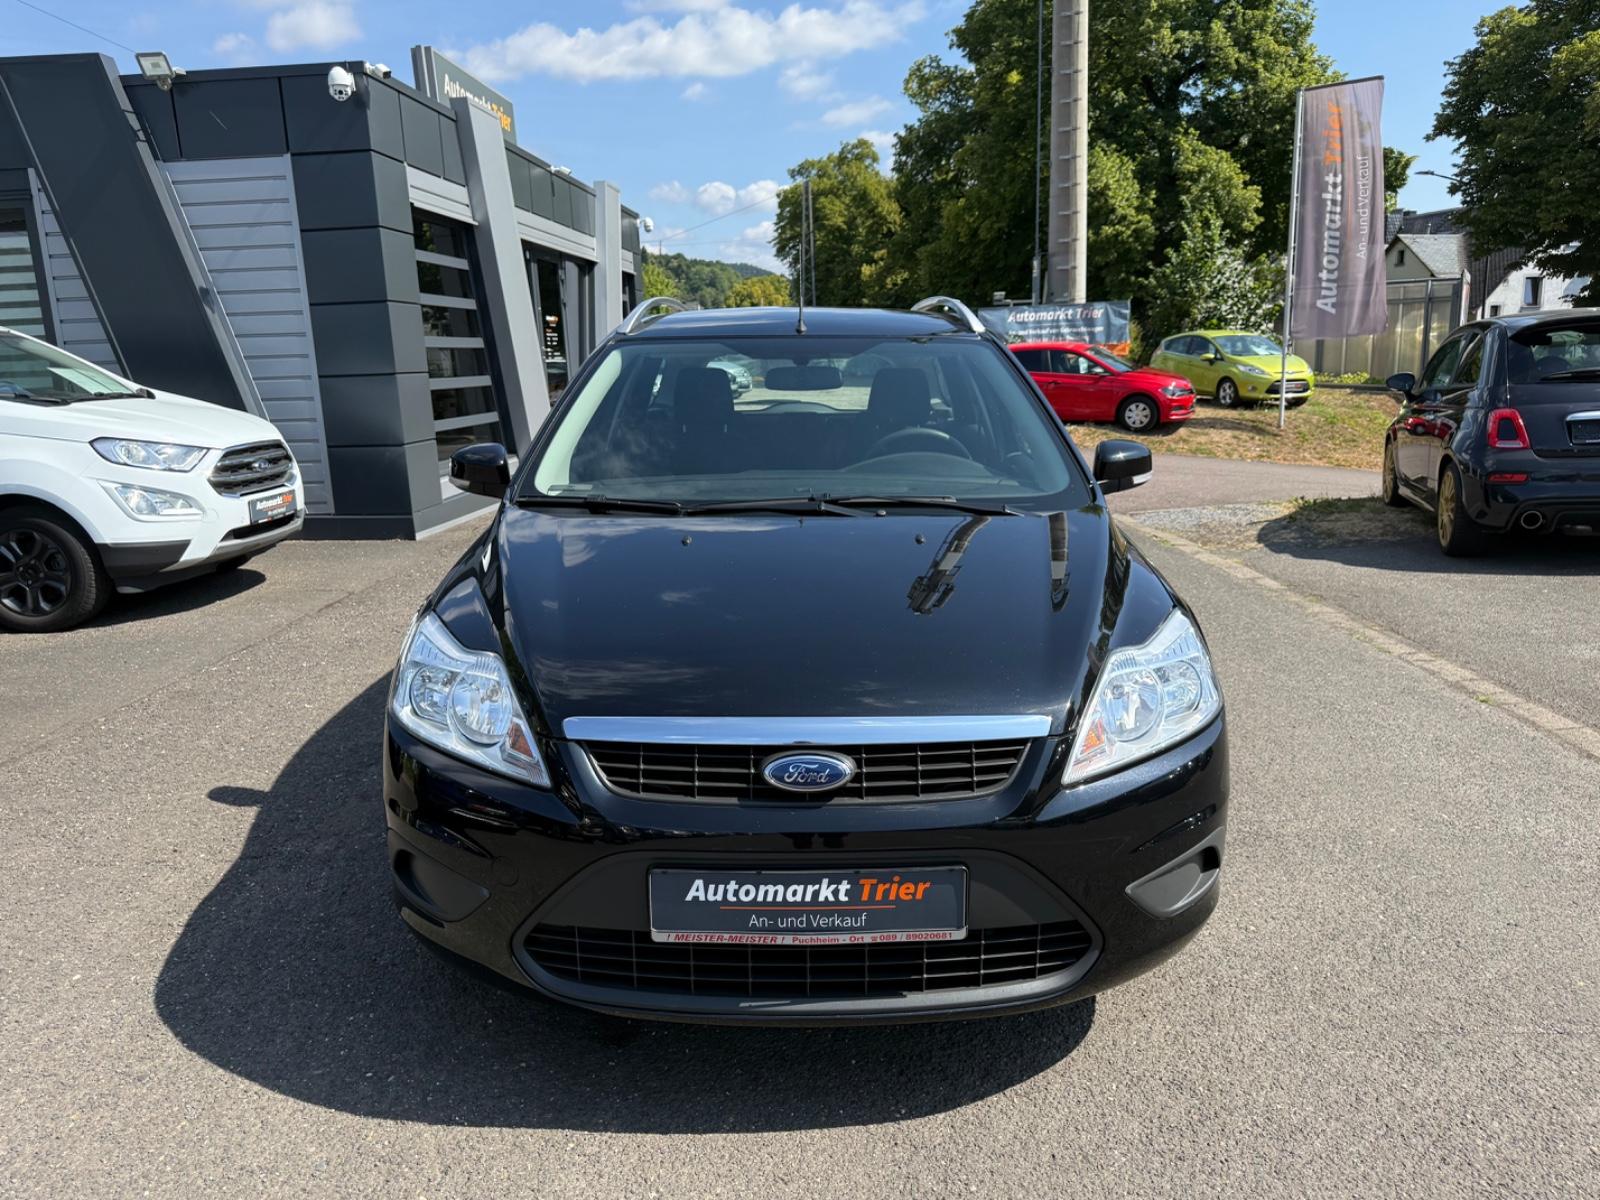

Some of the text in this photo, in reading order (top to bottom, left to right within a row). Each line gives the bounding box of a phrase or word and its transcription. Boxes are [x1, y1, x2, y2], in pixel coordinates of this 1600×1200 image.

[1316, 100, 1344, 315] Automarkt Trier
[1356, 154, 1369, 259] An- und Verkauf
[1007, 306, 1104, 323] Automarkt Trier
[784, 763, 830, 783] Ford
[684, 875, 931, 902] Automarkt Trier
[749, 912, 867, 928] An- und Verkauf
[674, 933, 778, 944] MEISTER-MEISTER
[792, 936, 840, 944] Puchheim
[849, 935, 865, 943] Ort
